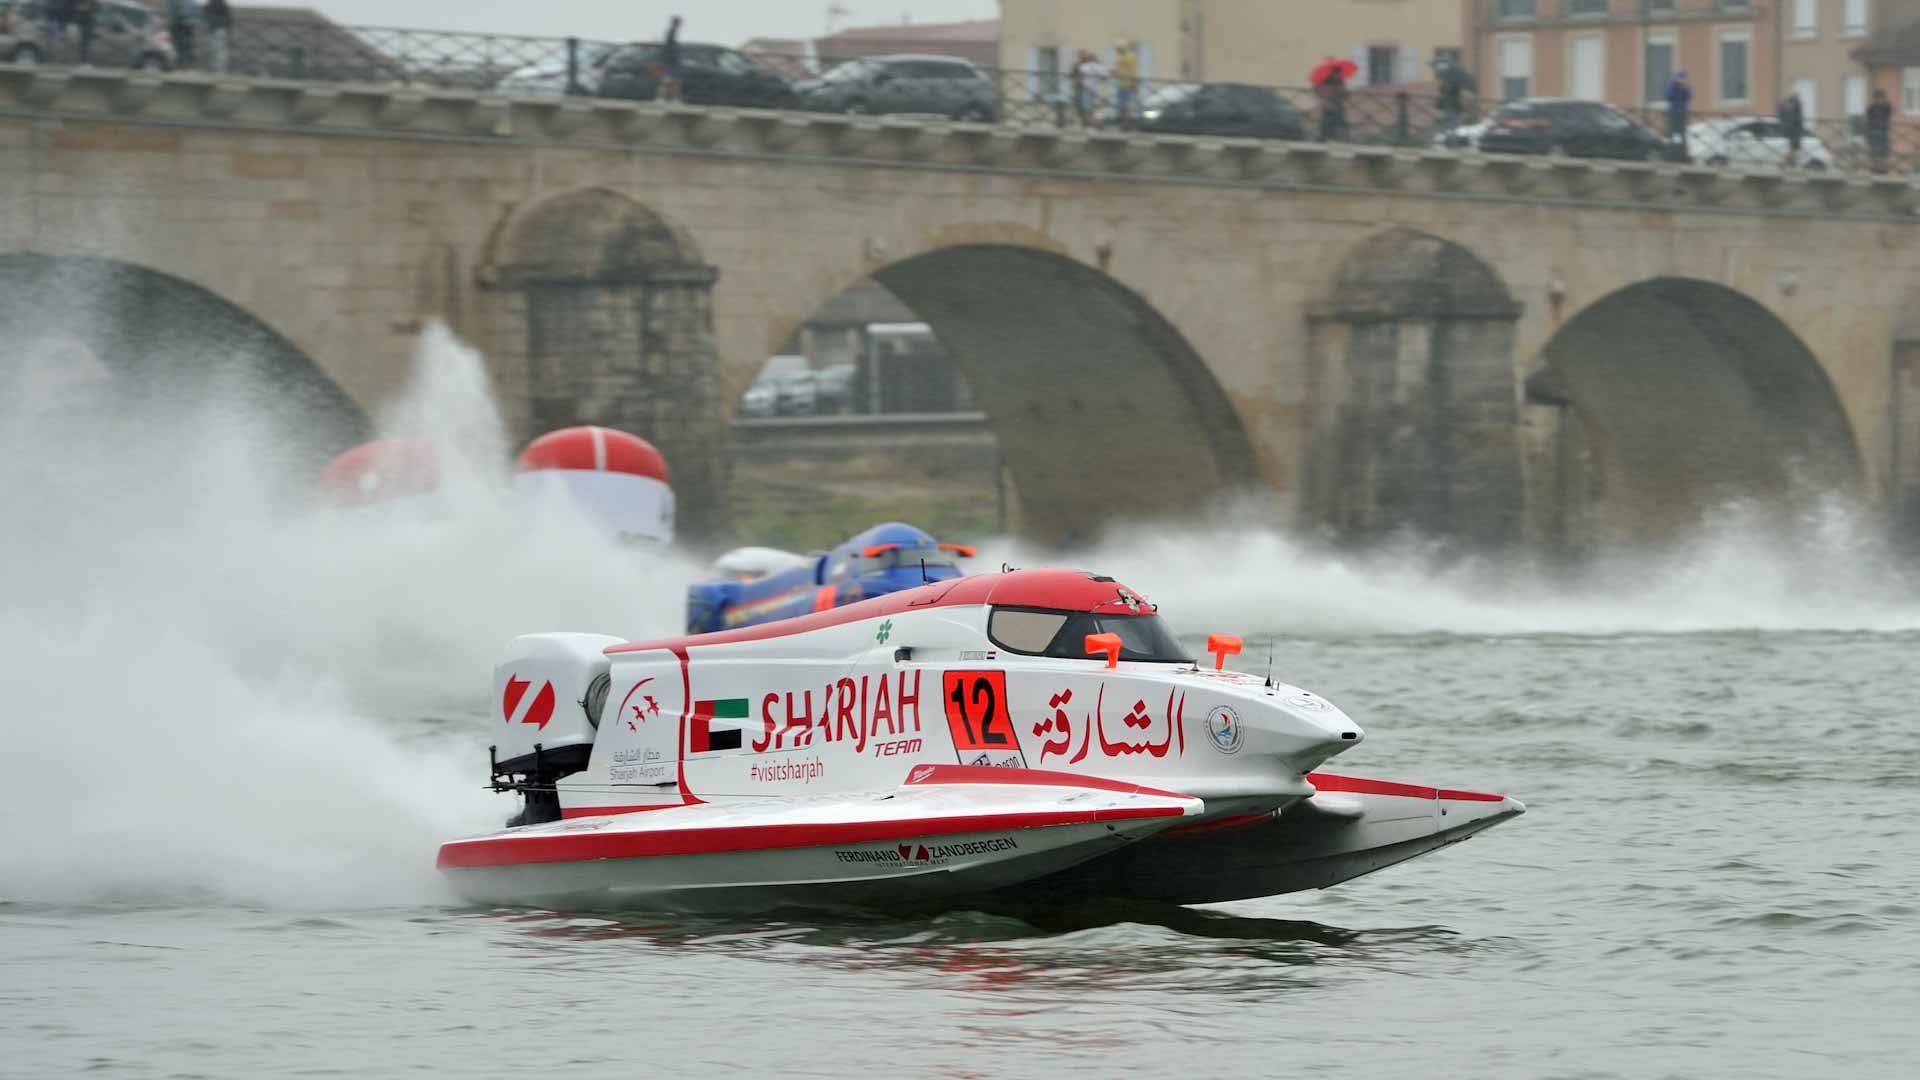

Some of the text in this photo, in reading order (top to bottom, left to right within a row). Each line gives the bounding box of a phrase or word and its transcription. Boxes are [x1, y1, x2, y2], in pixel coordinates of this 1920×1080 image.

[752, 669, 921, 753] SHARJAH
[951, 677, 1008, 745] 12
[1032, 681, 1186, 765] الشارقة
[874, 738, 922, 758] TEAM
[609, 766, 665, 782] Sharjah Airport
[751, 756, 824, 784] #visitsharjah
[835, 849, 899, 863] FERDINAND
[929, 838, 1017, 858] ZANDBERGEN
